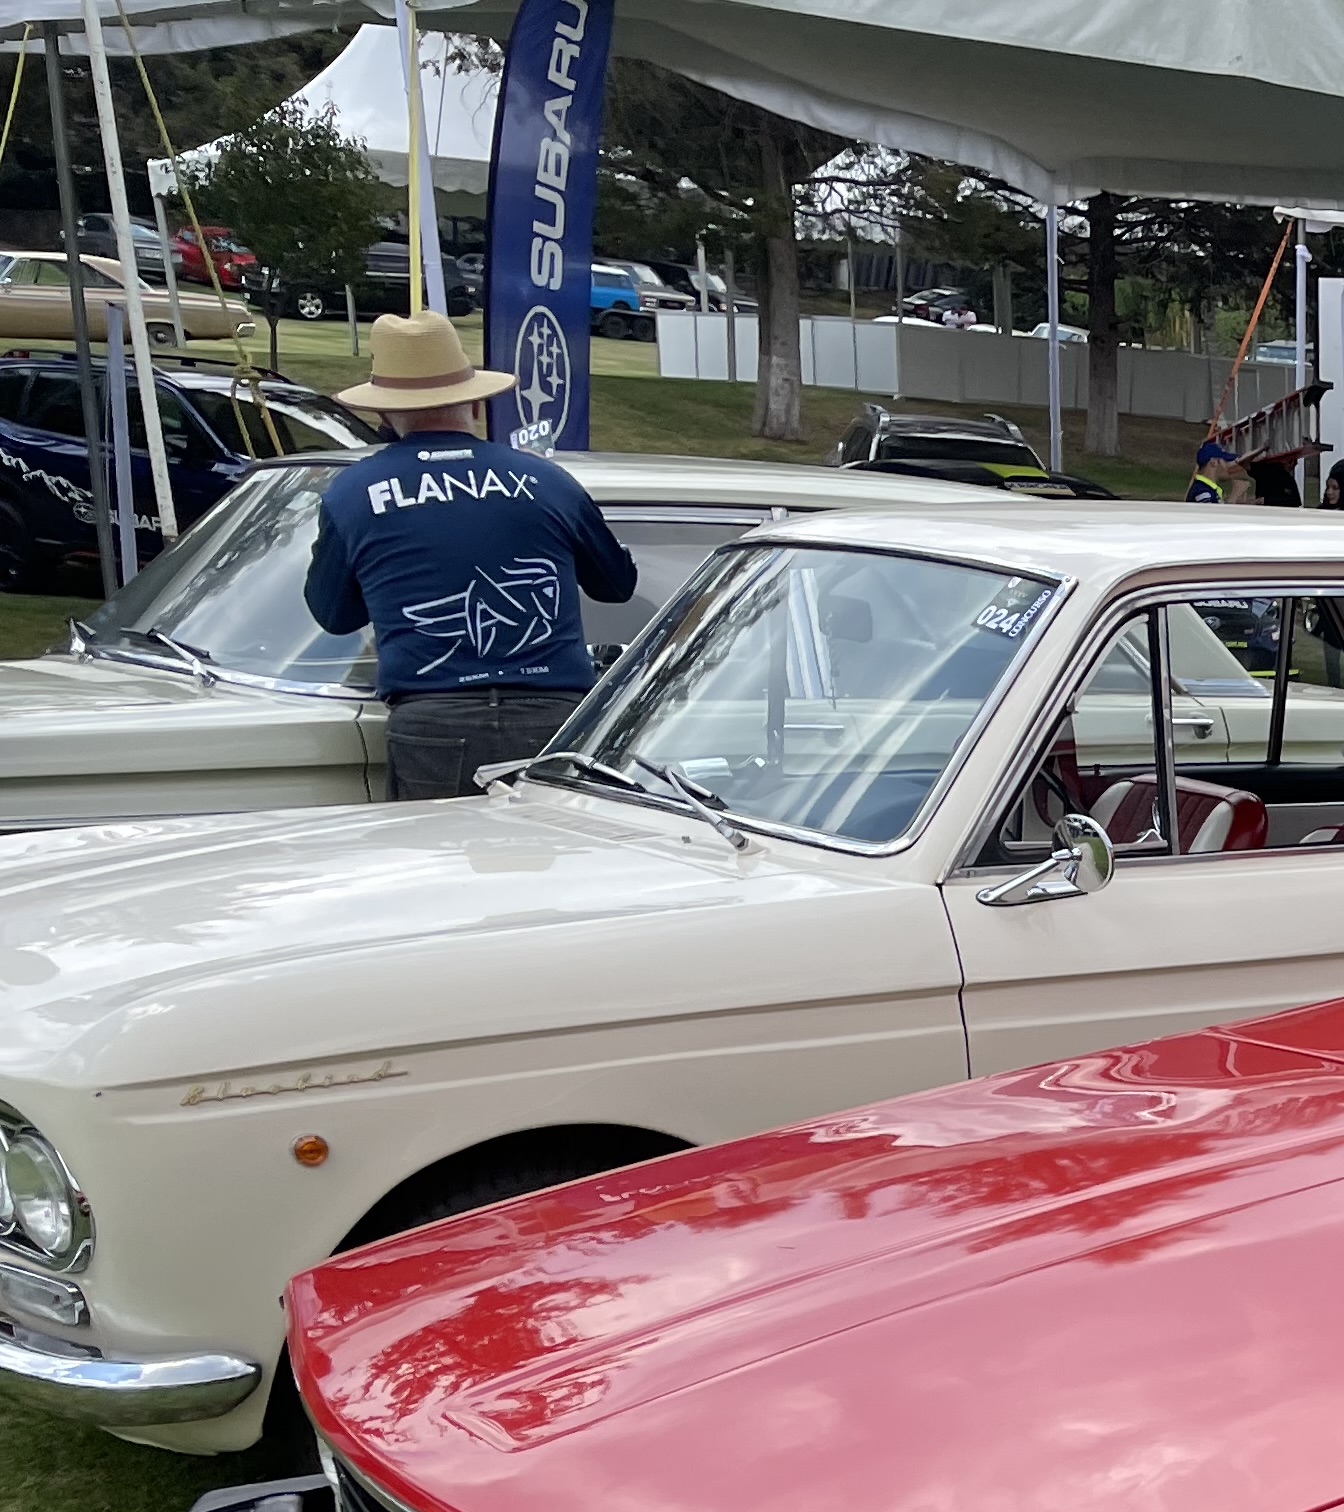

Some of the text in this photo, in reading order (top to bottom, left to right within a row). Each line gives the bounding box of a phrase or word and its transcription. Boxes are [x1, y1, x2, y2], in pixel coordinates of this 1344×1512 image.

[530, 0, 589, 291] SUBARU
[518, 420, 549, 445] 020
[368, 468, 536, 515] FLANAX
[976, 605, 1020, 633] 024
[1008, 589, 1051, 637] CONCURSO
